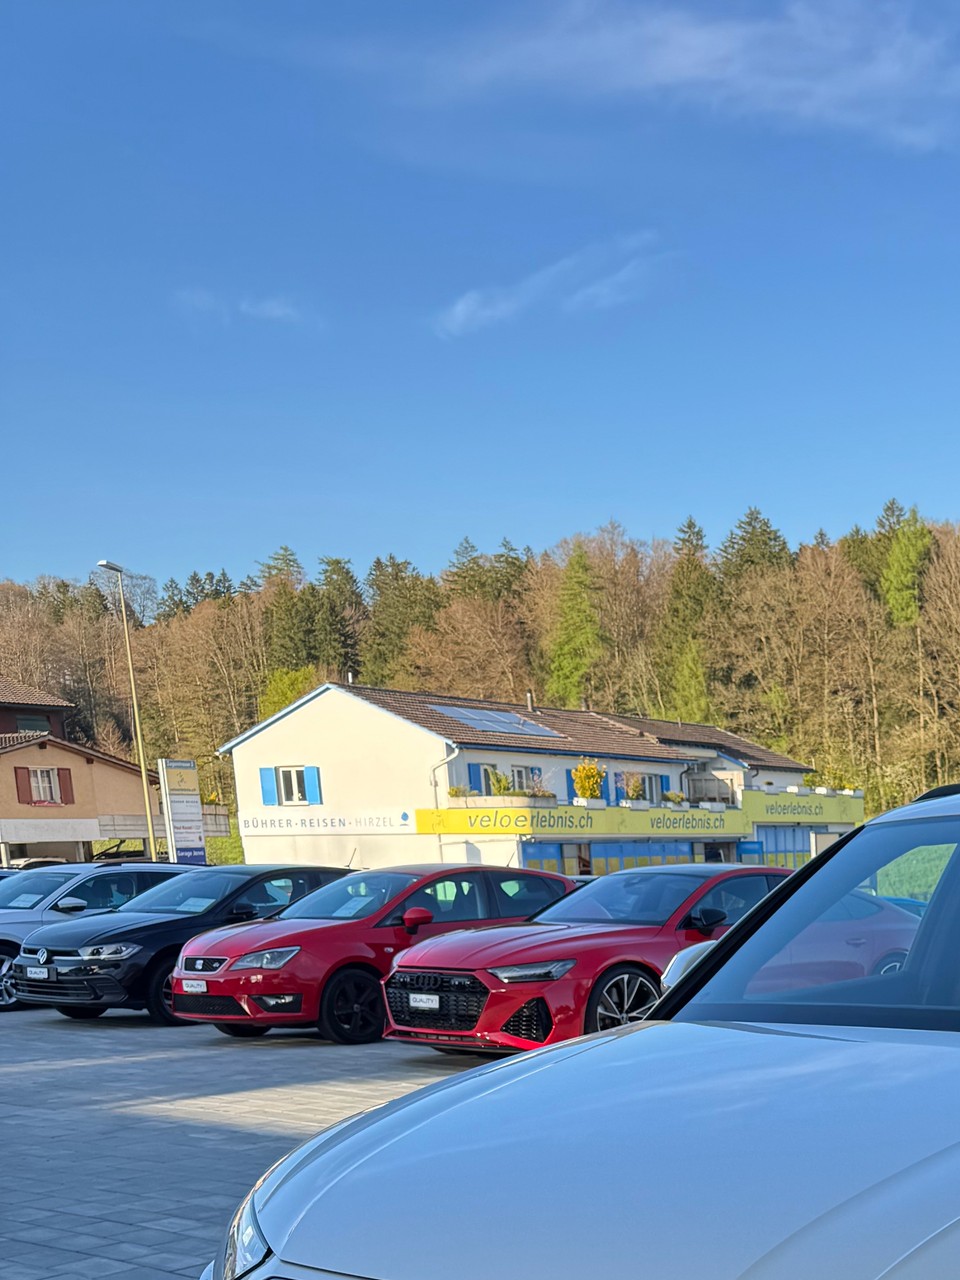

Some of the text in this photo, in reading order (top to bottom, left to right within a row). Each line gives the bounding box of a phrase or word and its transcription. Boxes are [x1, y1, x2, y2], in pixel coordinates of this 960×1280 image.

[765, 801, 824, 816] veloerlebnis.ch
[243, 817, 395, 829] BÜHRER REISEN HIRZEL
[468, 810, 593, 829] veloerlebnis.ch
[650, 813, 725, 830] veloerlebnis.ch
